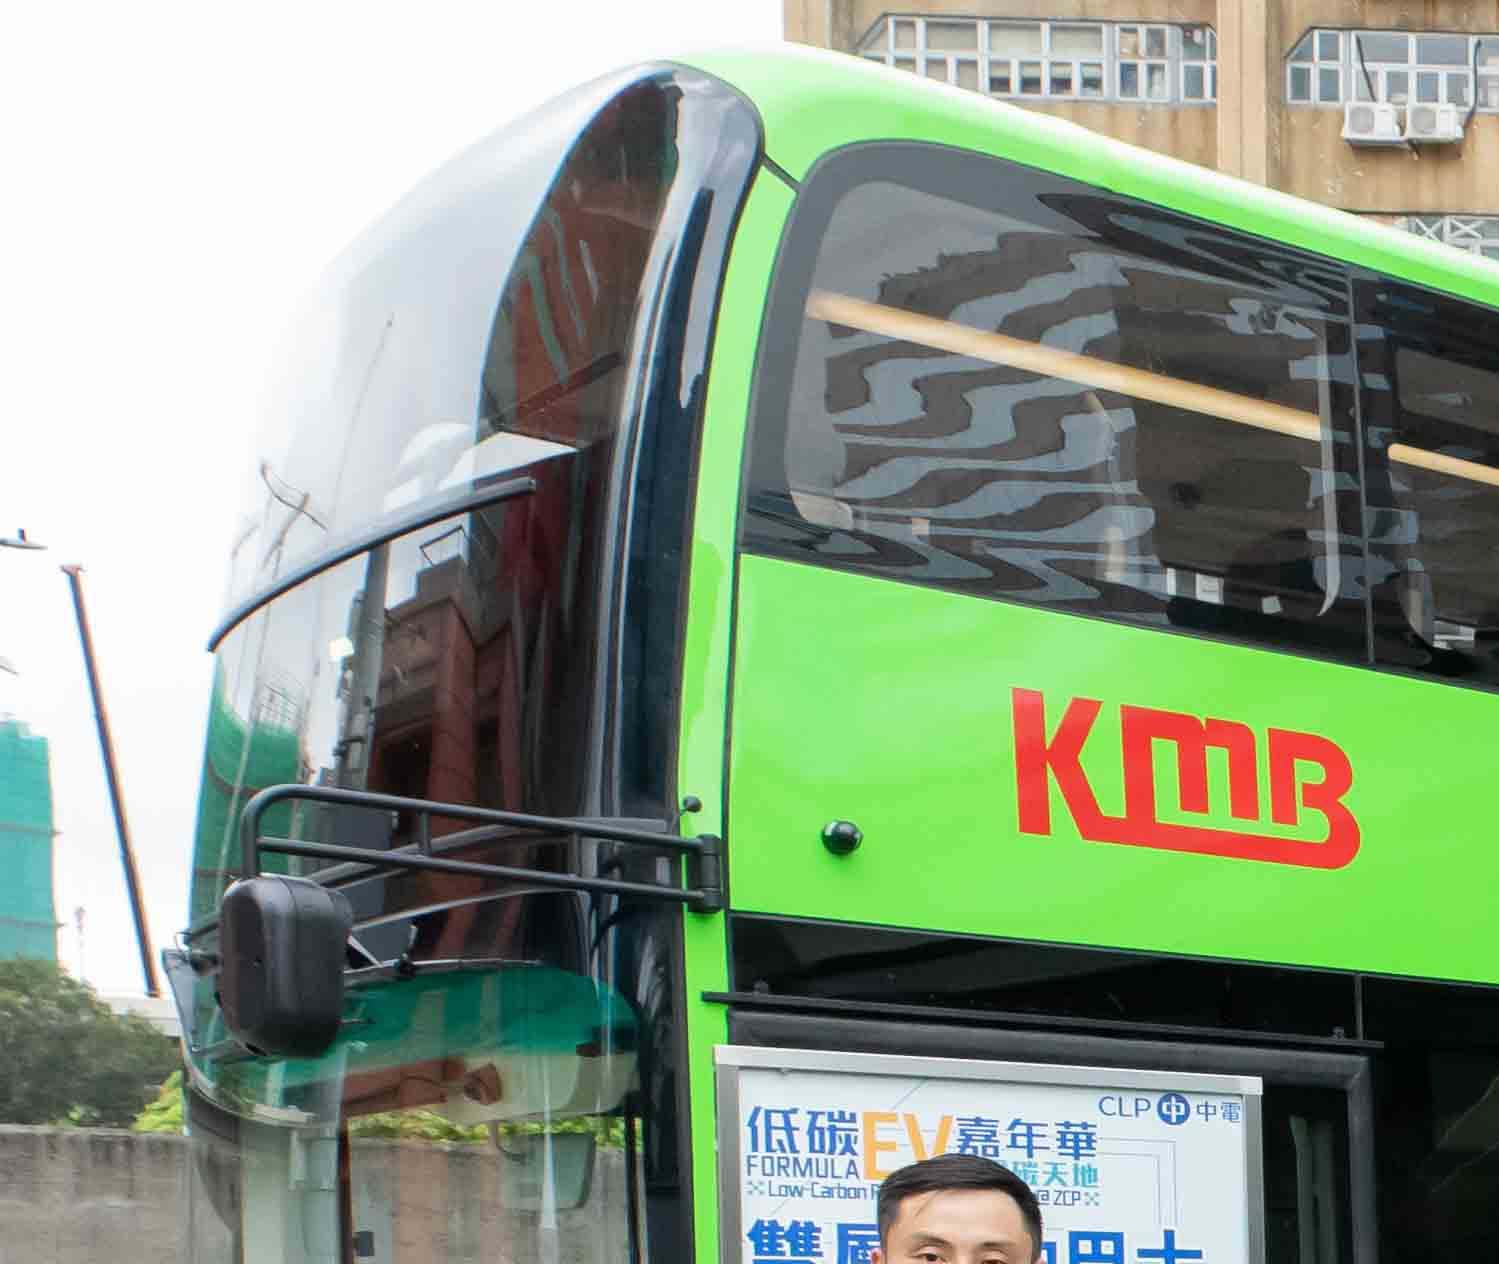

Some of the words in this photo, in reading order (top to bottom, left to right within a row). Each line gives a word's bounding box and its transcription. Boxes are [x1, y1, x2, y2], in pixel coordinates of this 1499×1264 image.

[1011, 687, 1361, 870] KMB
[1098, 1096, 1151, 1118] CLP
[1196, 1101, 1241, 1123] 中電
[746, 1155, 860, 1180] FORMULA
